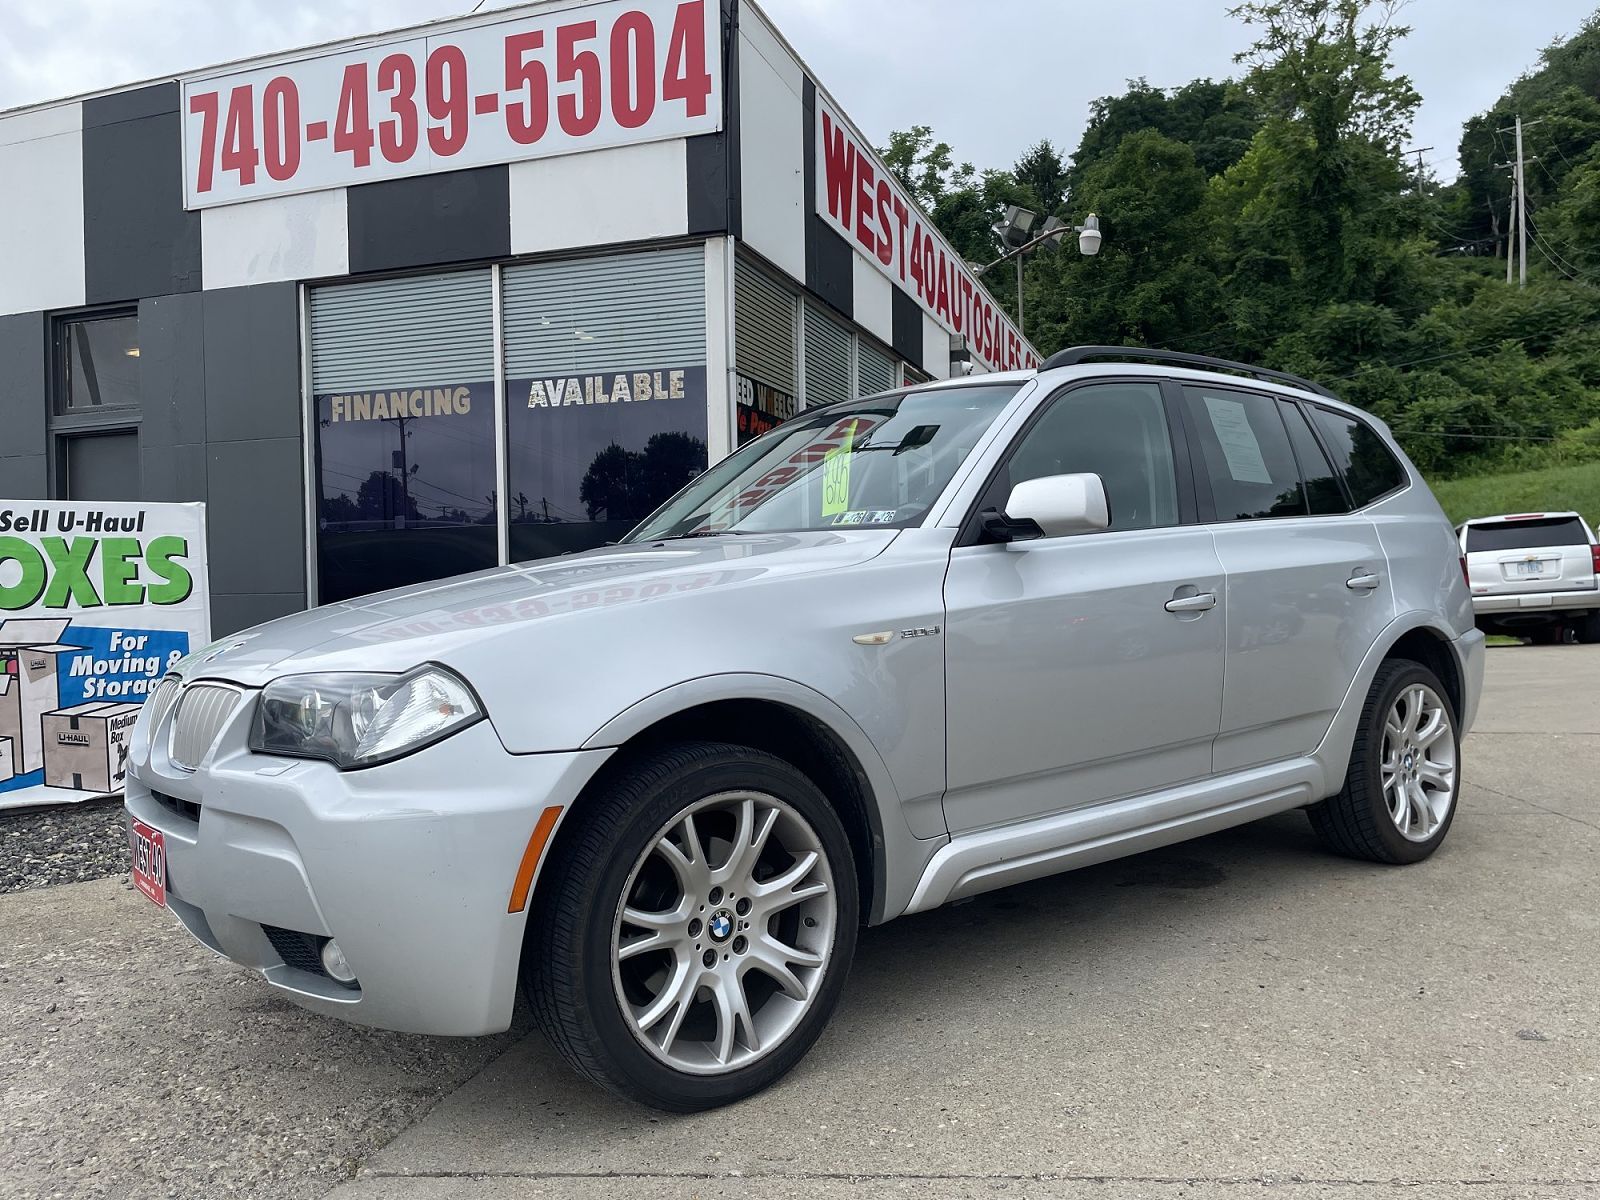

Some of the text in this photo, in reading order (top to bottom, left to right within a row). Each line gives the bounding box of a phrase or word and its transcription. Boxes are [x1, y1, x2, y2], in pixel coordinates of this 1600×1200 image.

[190, 1, 711, 193] 740-439-5504
[822, 109, 1040, 371] WEST40AUTOSALES
[332, 370, 685, 422] FINANCING AVAILABLE
[736, 375, 754, 407] EED
[0, 510, 146, 532] Sell U-Haul
[109, 631, 148, 652] For
[69, 651, 160, 677] Moving
[58, 733, 89, 743] U-HAUL
[110, 732, 124, 744] Box
[151, 841, 163, 887] 40
